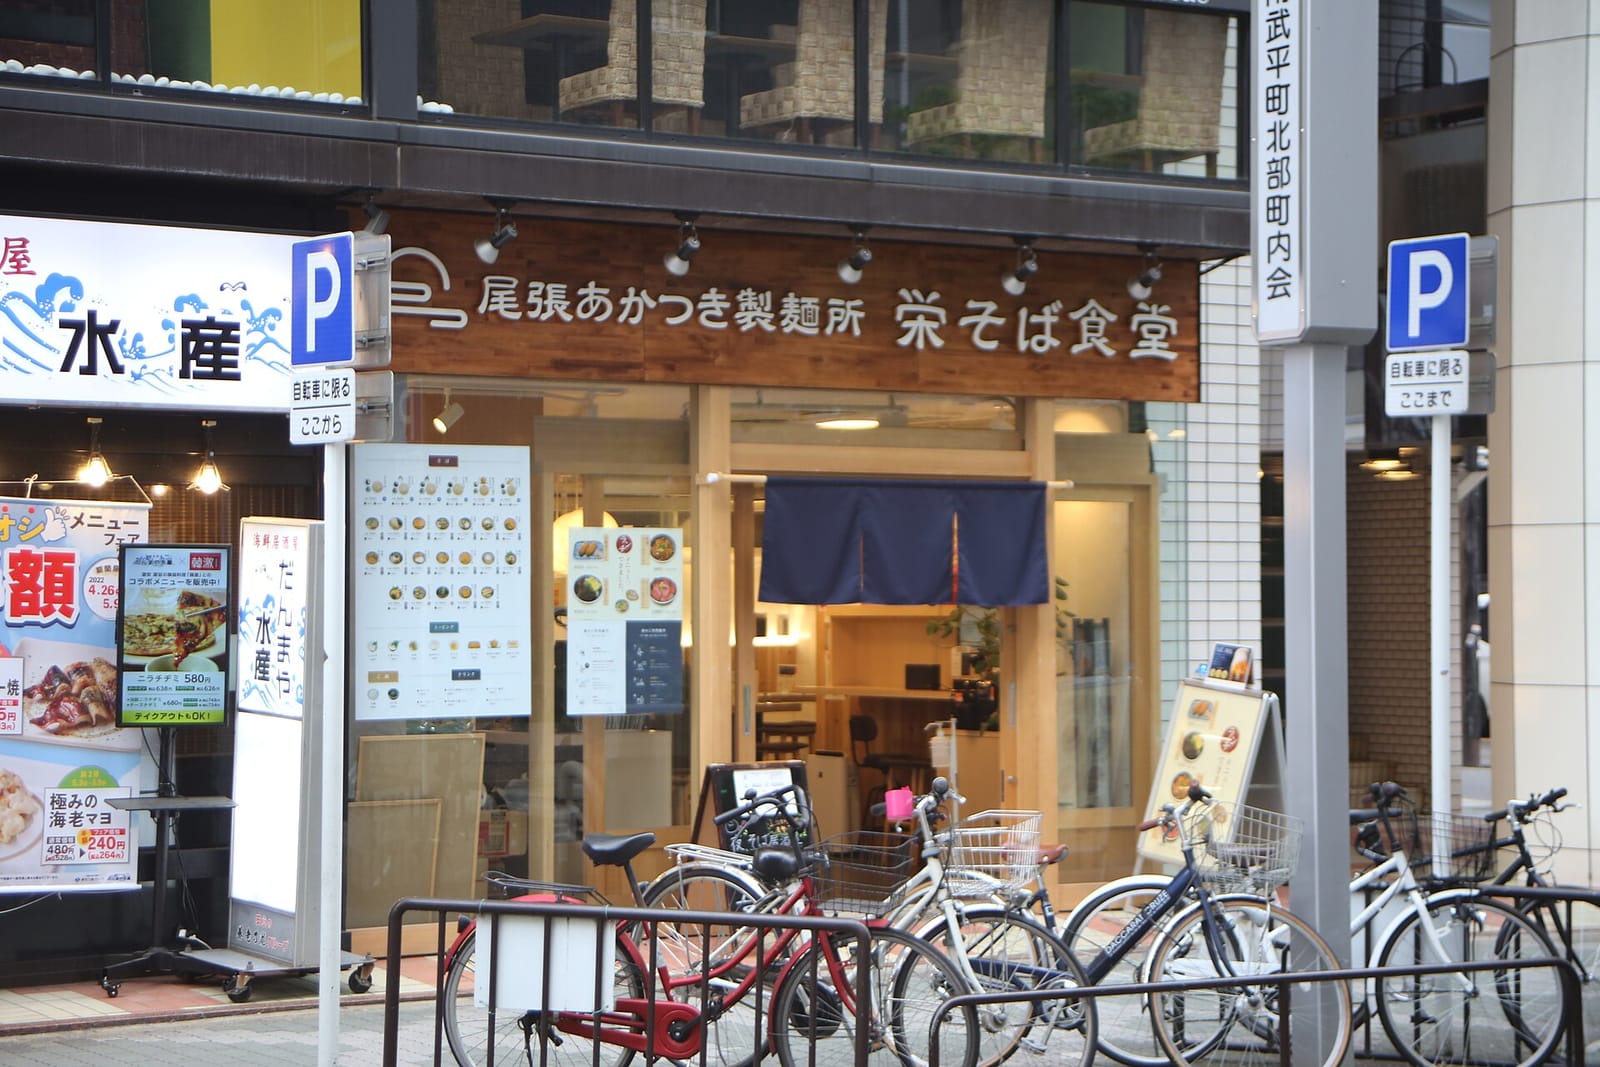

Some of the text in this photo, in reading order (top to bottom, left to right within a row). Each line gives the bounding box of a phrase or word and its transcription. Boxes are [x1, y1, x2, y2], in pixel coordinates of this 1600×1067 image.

[1265, 0, 1292, 301] 武平町北部町内会
[0, 237, 37, 276] 屋
[306, 251, 342, 353] P
[1407, 249, 1454, 338] P
[478, 275, 1179, 361] 尾張あかつき製麺所 栄そば食堂
[58, 309, 242, 381] 水産
[1391, 357, 1463, 378] 自転車に限る
[293, 377, 350, 401] 自転車に限る
[1401, 390, 1452, 408] ここまで
[301, 414, 342, 436] ここから
[69, 512, 140, 530] メニュー
[8, 549, 76, 619] 額
[88, 576, 105, 584] 2022
[276, 559, 294, 699] だんまや
[254, 611, 271, 681] 水産
[184, 673, 211, 684] 580円
[49, 793, 98, 811] 極みの
[49, 811, 112, 828] 海老マヨ
[88, 836, 126, 851] 240円
